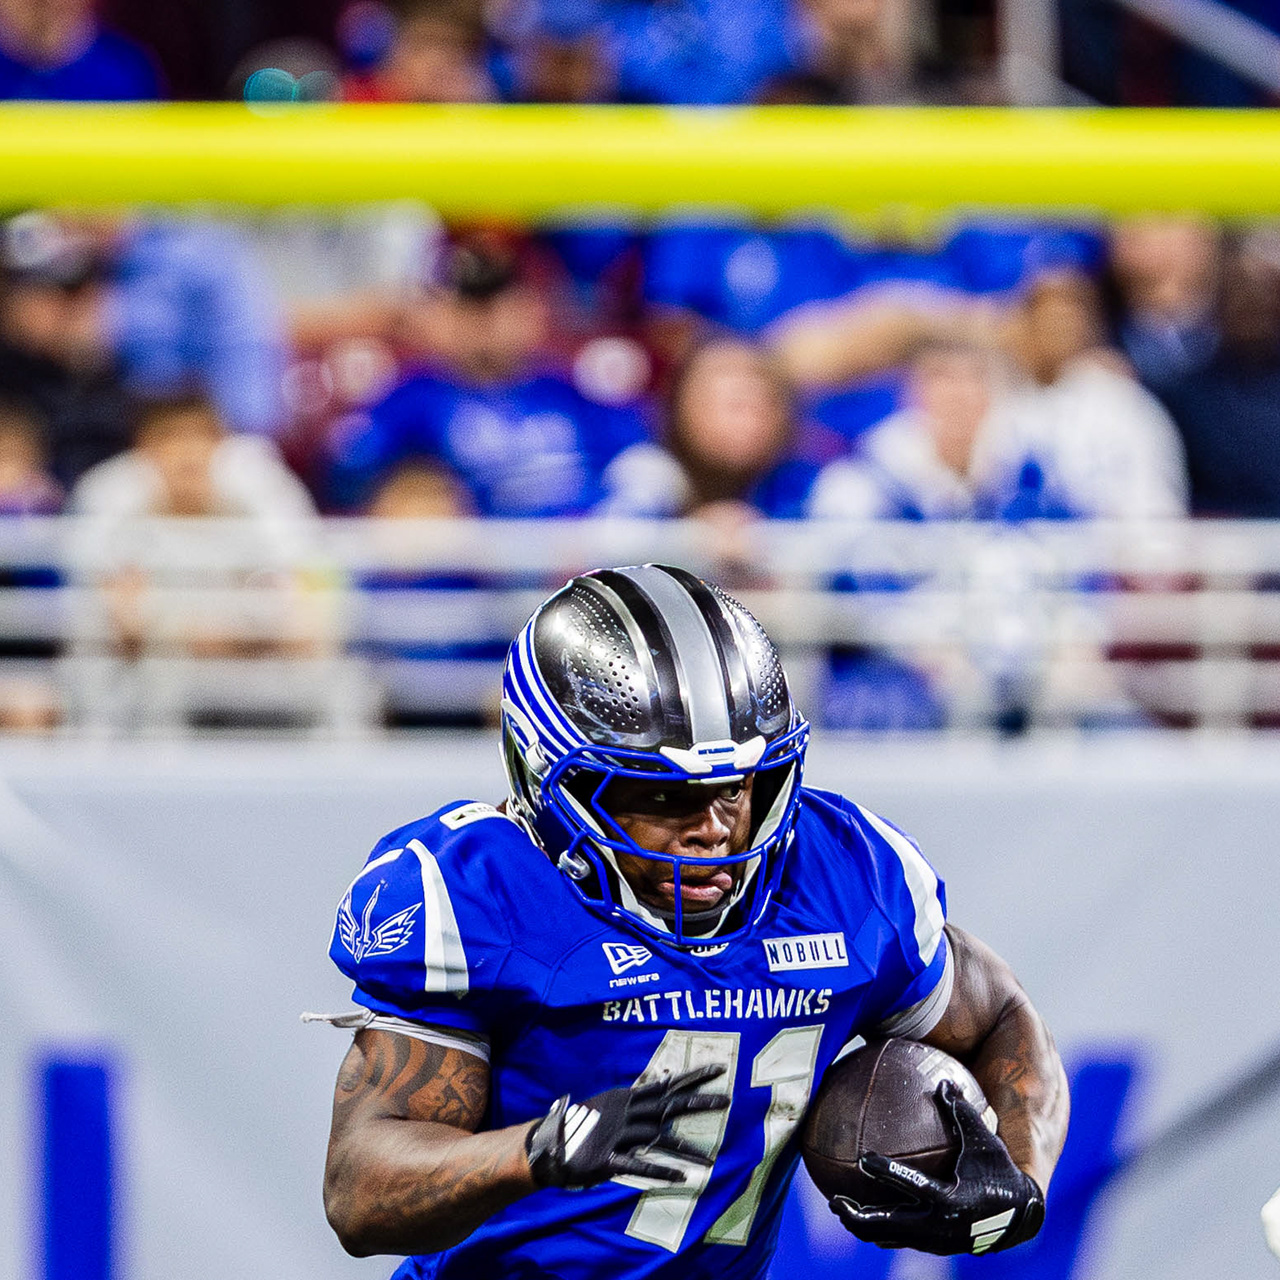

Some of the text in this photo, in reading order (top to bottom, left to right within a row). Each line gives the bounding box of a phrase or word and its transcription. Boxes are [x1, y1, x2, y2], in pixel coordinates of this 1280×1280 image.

[768, 938, 846, 966] NOBULL
[602, 988, 833, 1022] BATTLEHAWKS
[610, 1023, 826, 1254] 41
